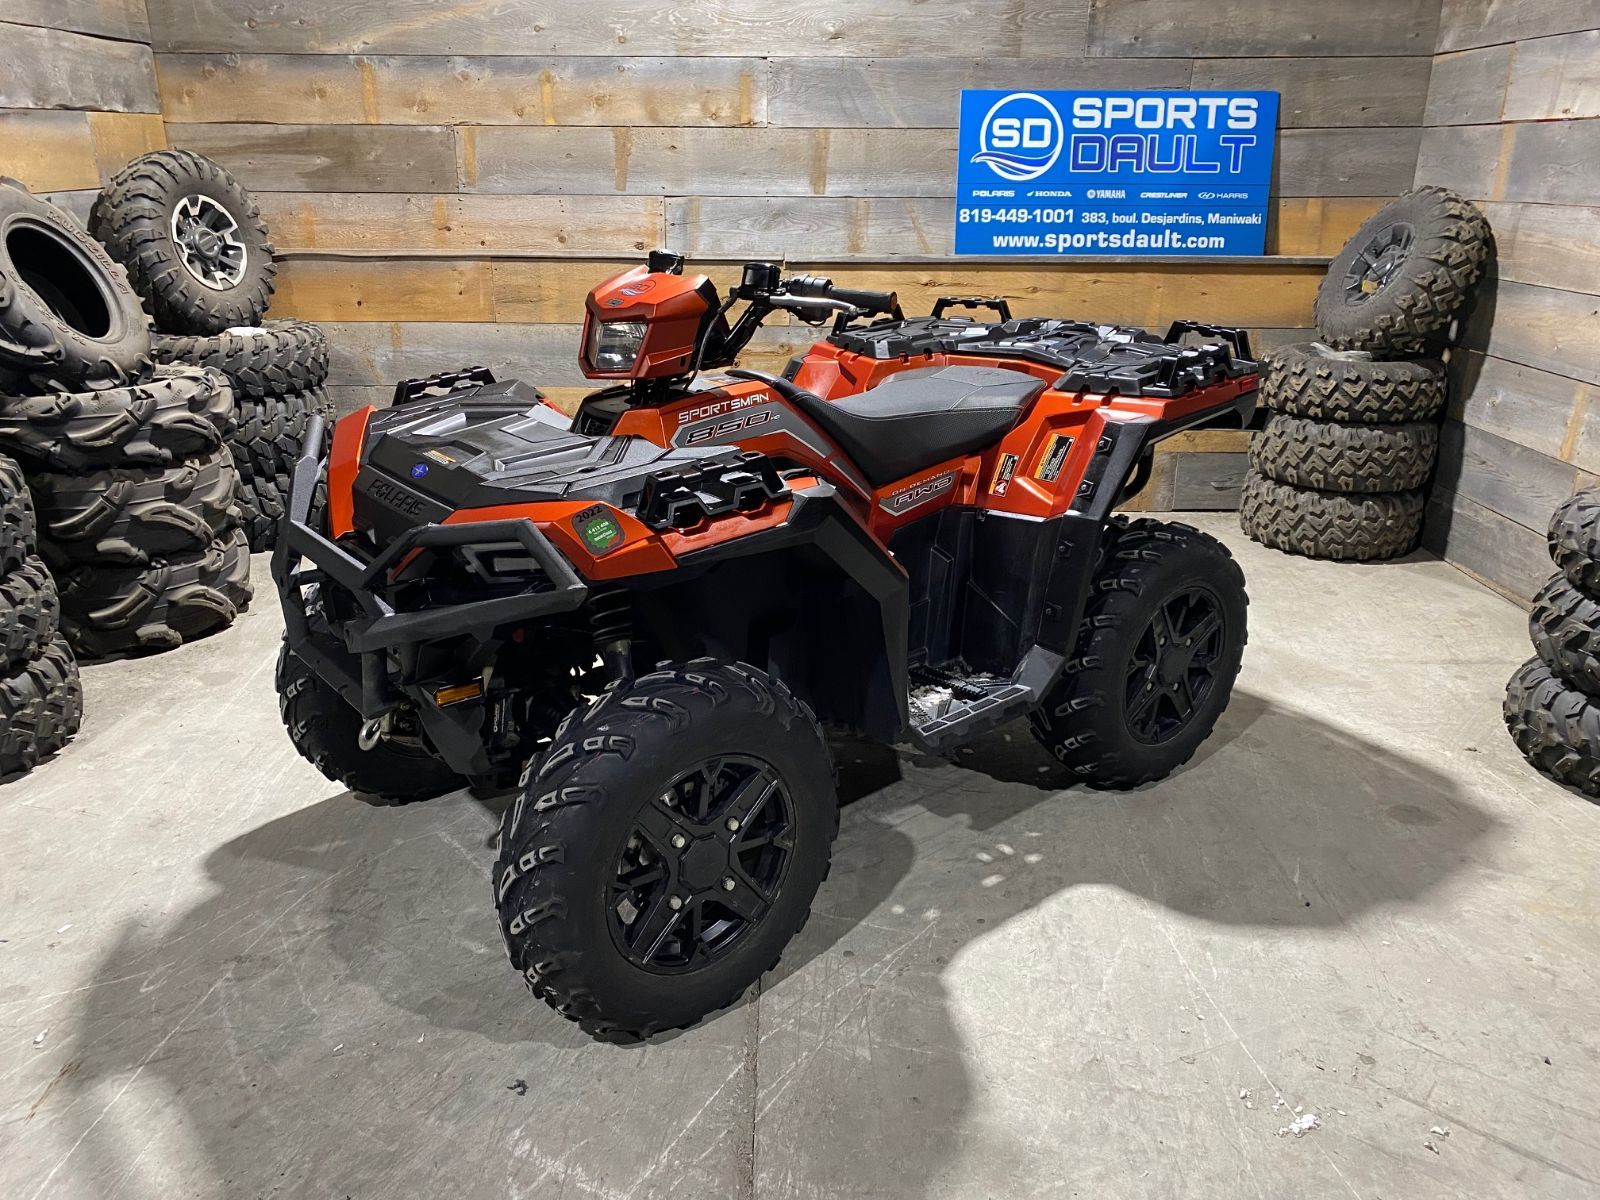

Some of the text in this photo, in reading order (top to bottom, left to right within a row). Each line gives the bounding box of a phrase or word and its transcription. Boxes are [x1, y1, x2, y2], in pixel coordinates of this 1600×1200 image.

[1072, 97, 1259, 129] SPORTS
[991, 118, 1052, 148] SD
[1069, 133, 1257, 174] DAULT
[1096, 189, 1126, 199] YAMAHA
[959, 208, 1074, 223] 819-449-1001
[1081, 212, 1262, 226] 383, boul. Desjardins, Maniwaki
[992, 228, 1225, 253] www.sportsdault.com
[678, 392, 769, 423] SPORTSMAN
[685, 410, 771, 445] 850
[366, 478, 426, 516] POLARIS
[891, 469, 951, 496] ON DEMAND
[894, 475, 953, 507] AWD
[575, 505, 604, 523] 2022
